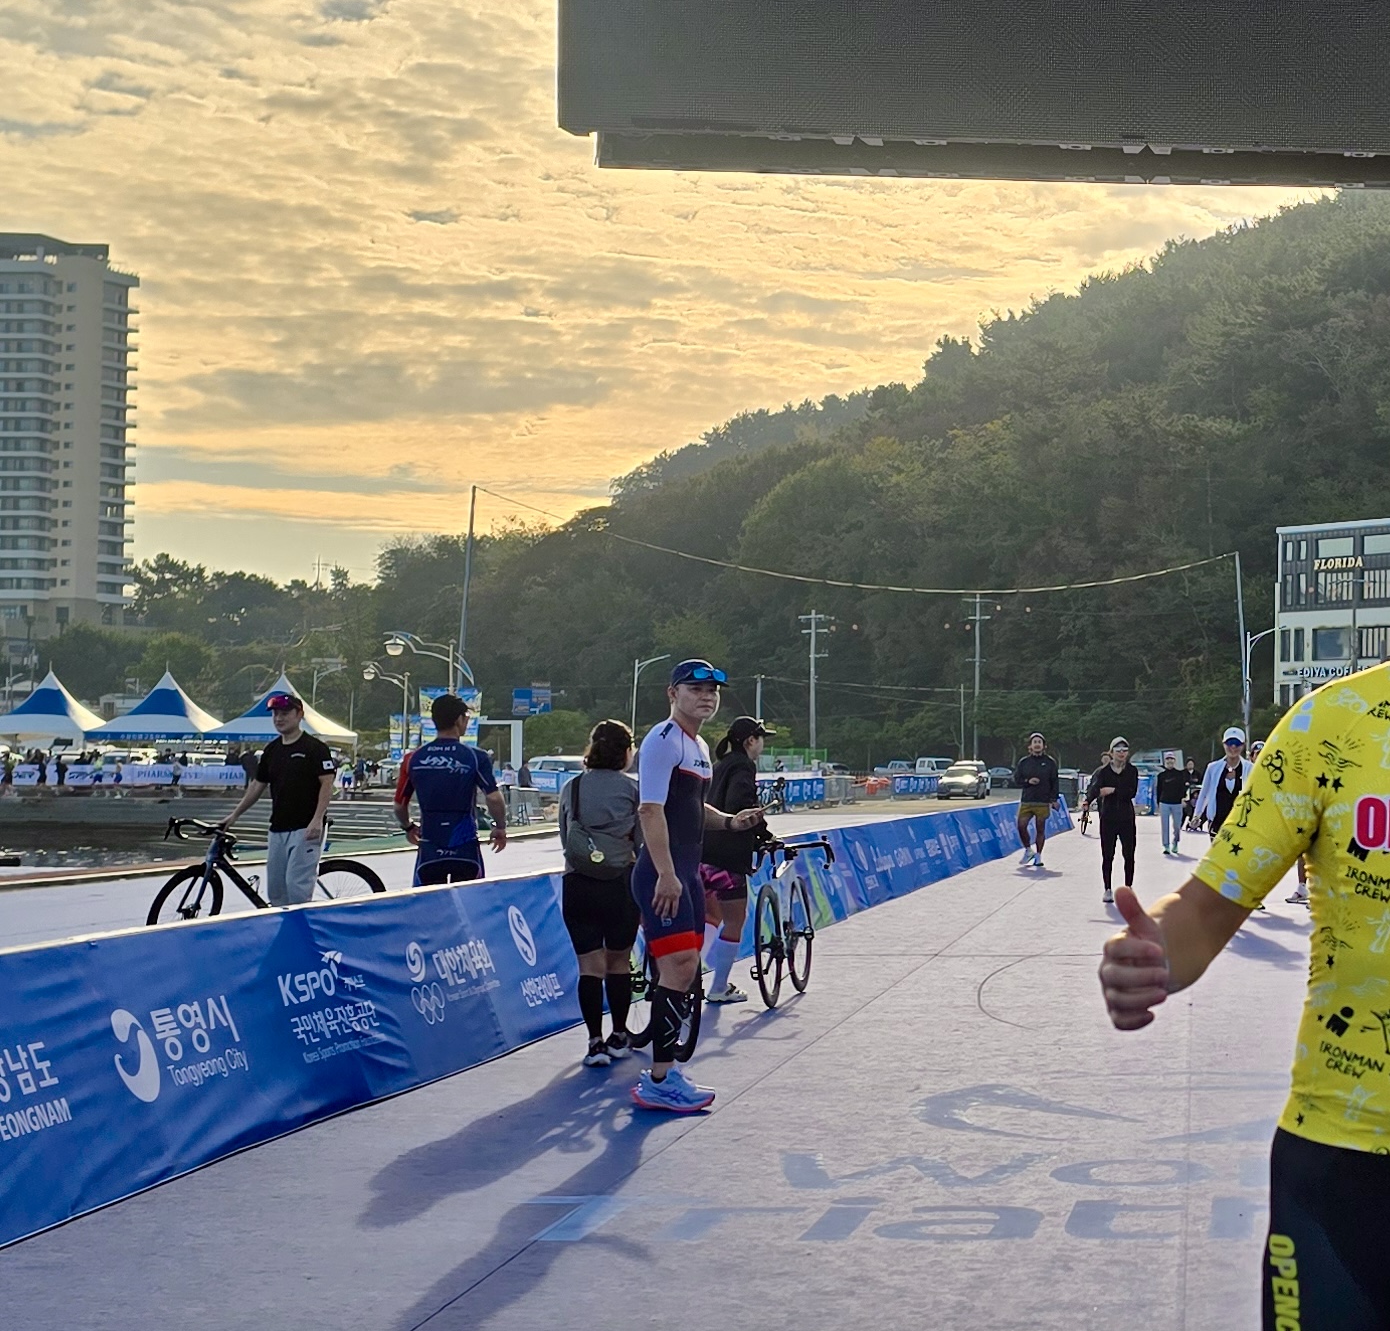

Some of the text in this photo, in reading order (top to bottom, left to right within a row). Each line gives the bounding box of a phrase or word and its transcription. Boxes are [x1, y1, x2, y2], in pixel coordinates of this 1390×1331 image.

[1313, 556, 1363, 570] FLORIDA
[1298, 667, 1327, 677] EDIYA
[277, 968, 336, 1007] KSPO
[150, 995, 241, 1061] 통영시
[291, 1000, 380, 1046] 국민체육진흥공단
[167, 1048, 249, 1087] Tongyeong City
[1319, 1040, 1385, 1073] IRONMAN
[1325, 1057, 1366, 1079] CREW
